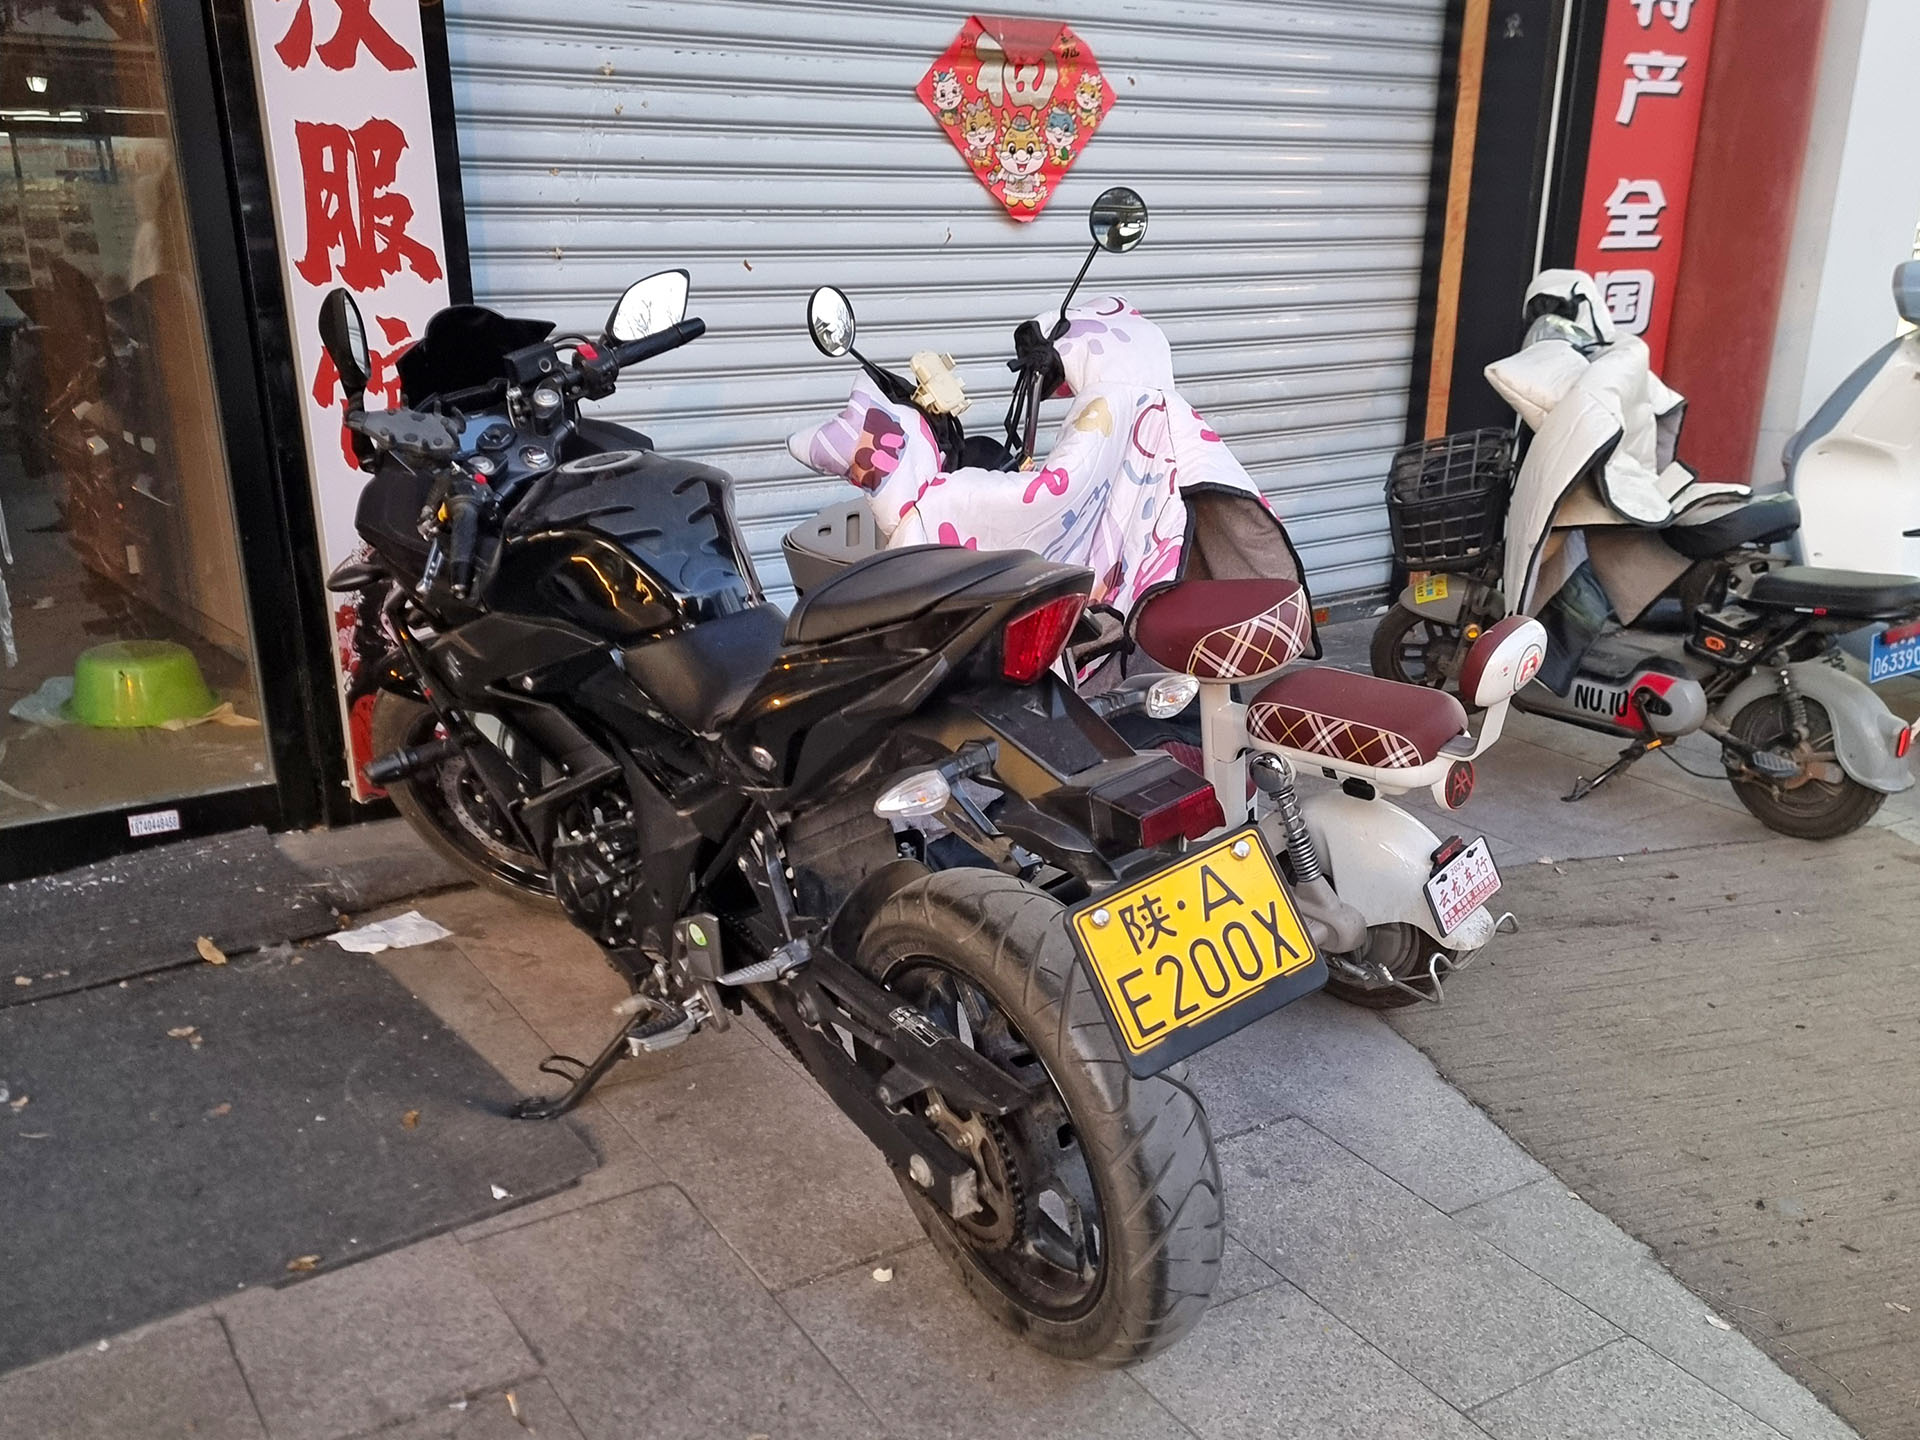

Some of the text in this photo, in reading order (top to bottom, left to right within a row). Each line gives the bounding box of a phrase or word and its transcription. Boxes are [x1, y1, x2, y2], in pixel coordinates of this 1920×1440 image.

[1593, 178, 1668, 336] 全国
[1574, 684, 1630, 717] NU.10
[1117, 864, 1244, 956] 陕·A
[1439, 856, 1489, 909] 云龙车行
[1116, 901, 1301, 1038] E200X
